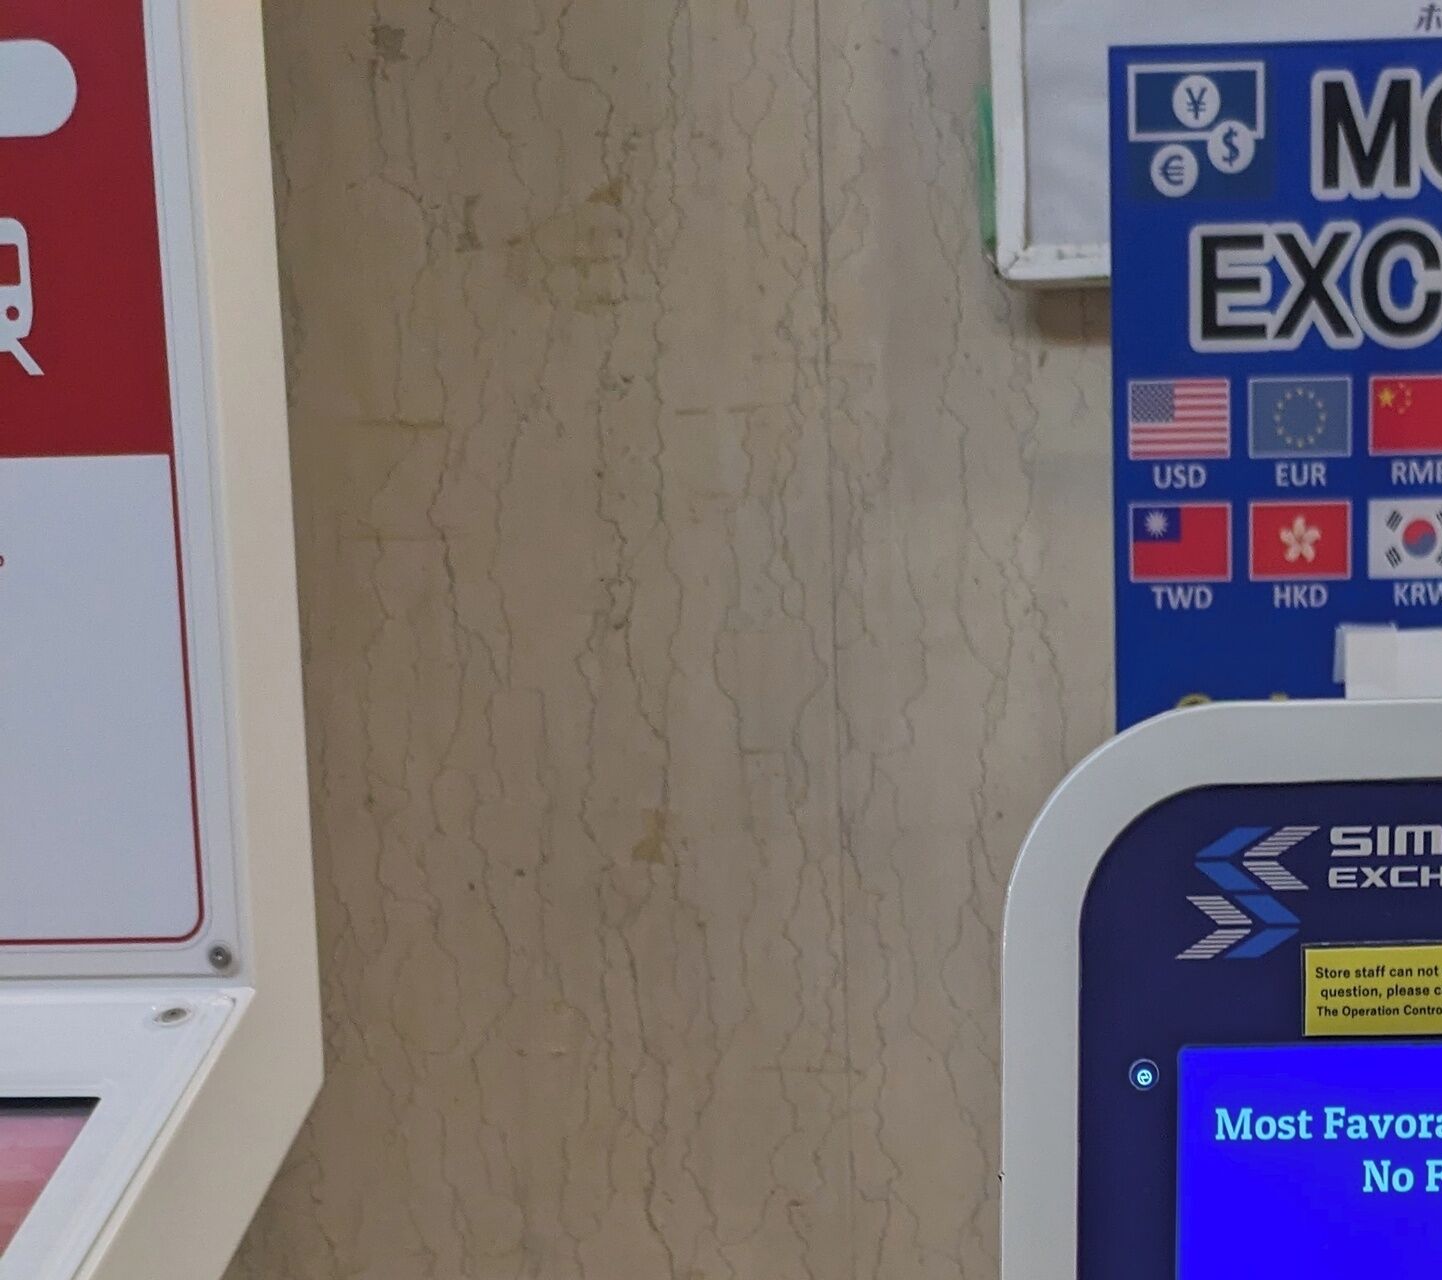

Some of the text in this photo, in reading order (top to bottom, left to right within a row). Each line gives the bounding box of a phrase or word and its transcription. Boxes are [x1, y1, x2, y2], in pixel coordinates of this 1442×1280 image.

[1152, 465, 1207, 489] USD
[1275, 462, 1328, 487] EUR
[1151, 585, 1214, 610] TWD
[1272, 584, 1328, 609] HKD
[1315, 966, 1351, 979] Store
[1354, 965, 1386, 978] staff
[1389, 968, 1413, 977] can
[1417, 965, 1439, 977] not
[1320, 985, 1382, 1000] question,
[1386, 983, 1430, 999] please
[1316, 1006, 1338, 1017] The
[1341, 1005, 1400, 1018] Operation
[1214, 1106, 1313, 1141] Most
[1361, 1158, 1415, 1194] No
